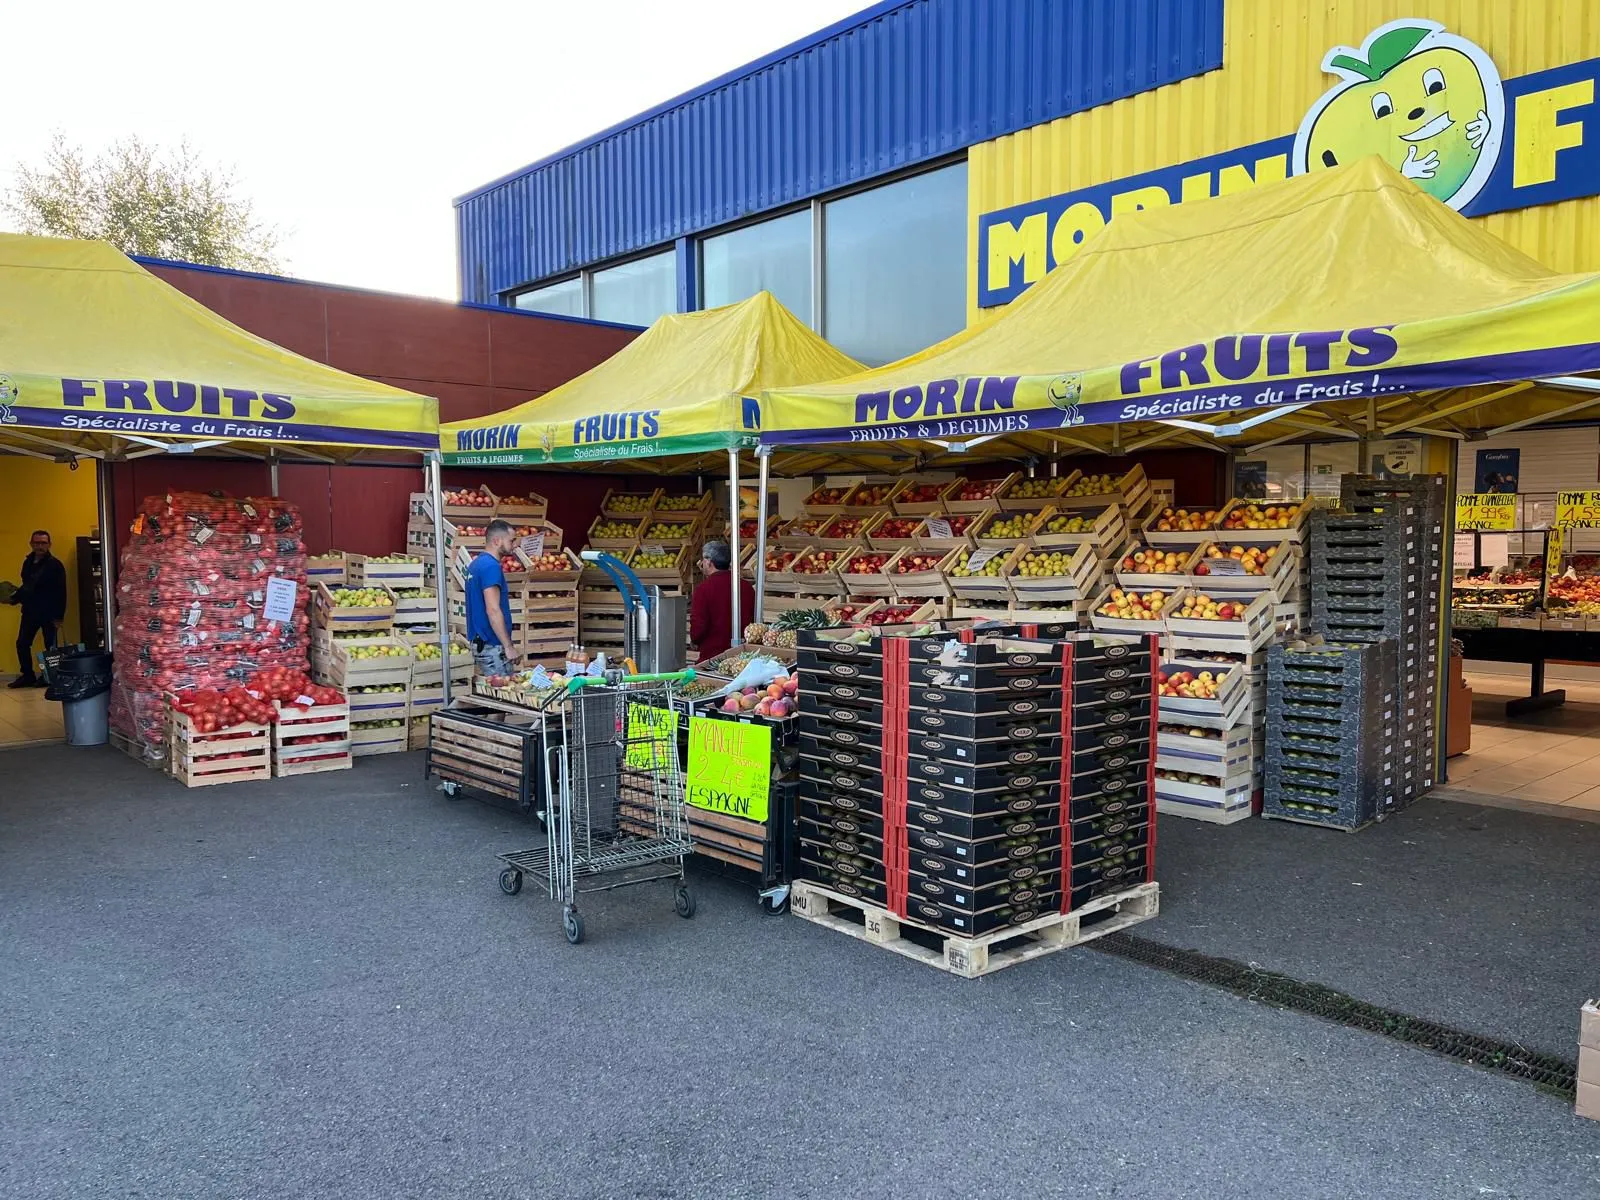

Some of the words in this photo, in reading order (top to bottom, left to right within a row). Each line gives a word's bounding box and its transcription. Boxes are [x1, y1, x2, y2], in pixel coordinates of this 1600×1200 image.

[1120, 324, 1399, 395] FRUITS
[61, 378, 297, 420] FRUITS
[855, 376, 1021, 423] MORIN
[1120, 392, 1242, 420] Spécialiste
[1254, 387, 1283, 405] du
[60, 414, 181, 432] Spécialiste
[191, 421, 215, 434] du
[457, 424, 521, 451] MORIN
[573, 410, 660, 443] FRUITS
[849, 425, 909, 442] FRUITS
[917, 424, 930, 438] &
[938, 414, 1030, 436] LEGUMES
[456, 456, 481, 464] FRUITS
[489, 454, 523, 464] LEGUMES
[574, 447, 616, 460] Spécialiste
[618, 445, 629, 456] du
[1457, 495, 1480, 507] POMME
[1558, 492, 1590, 506] POMME
[1458, 520, 1494, 529] FRANCE
[1558, 520, 1600, 529] FRANCE
[693, 721, 752, 757] MANGUE
[690, 784, 754, 814] ESPAGNE
